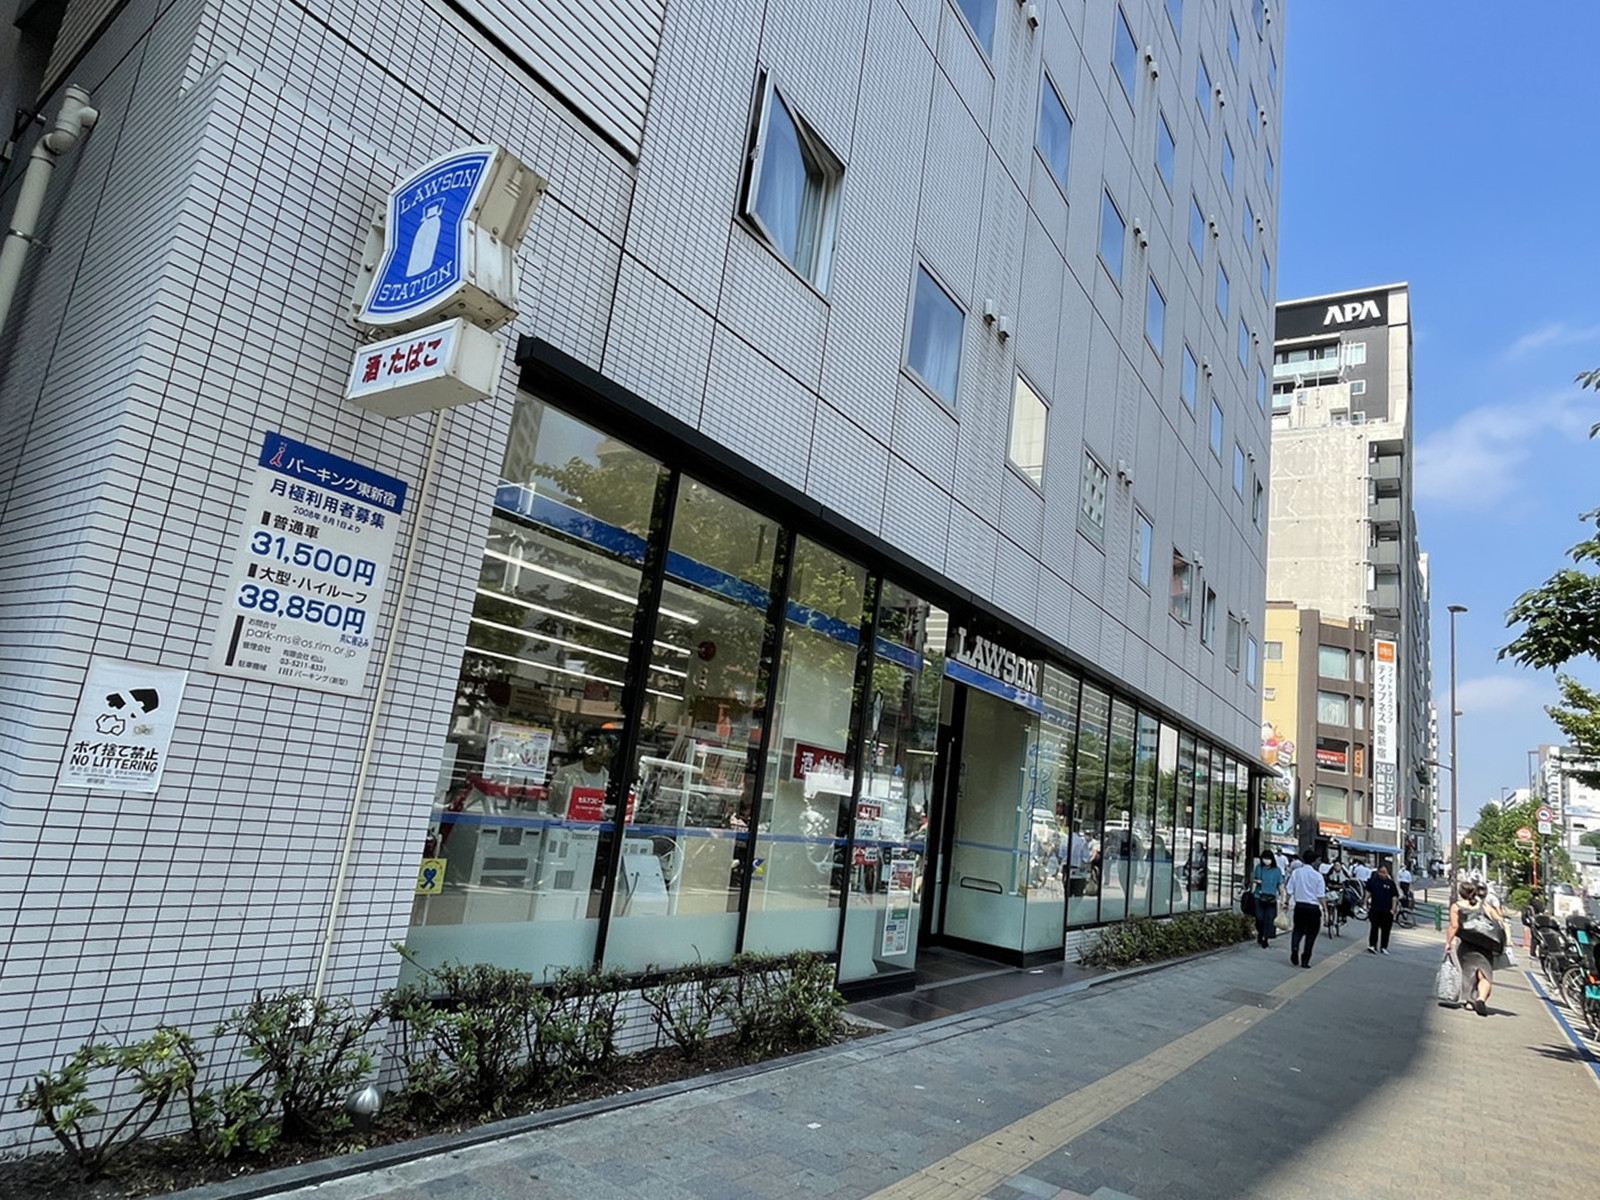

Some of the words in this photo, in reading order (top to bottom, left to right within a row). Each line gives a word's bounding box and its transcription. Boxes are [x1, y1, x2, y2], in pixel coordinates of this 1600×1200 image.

[400, 169, 477, 214] LAWSON
[379, 261, 453, 301] STATION
[1323, 300, 1381, 325] APA
[362, 338, 442, 383] 酒・たばこ
[270, 478, 386, 530] 月極利用者募集
[286, 457, 397, 508] パーキング東新宿
[273, 514, 320, 539] 普通車
[251, 531, 376, 587] 31,500円
[259, 567, 367, 604] 大型・ハイルーフ
[238, 584, 366, 634] 38,850円
[956, 627, 1040, 694] LAWSON
[69, 754, 89, 766] NO
[92, 756, 158, 773] LITTERING
